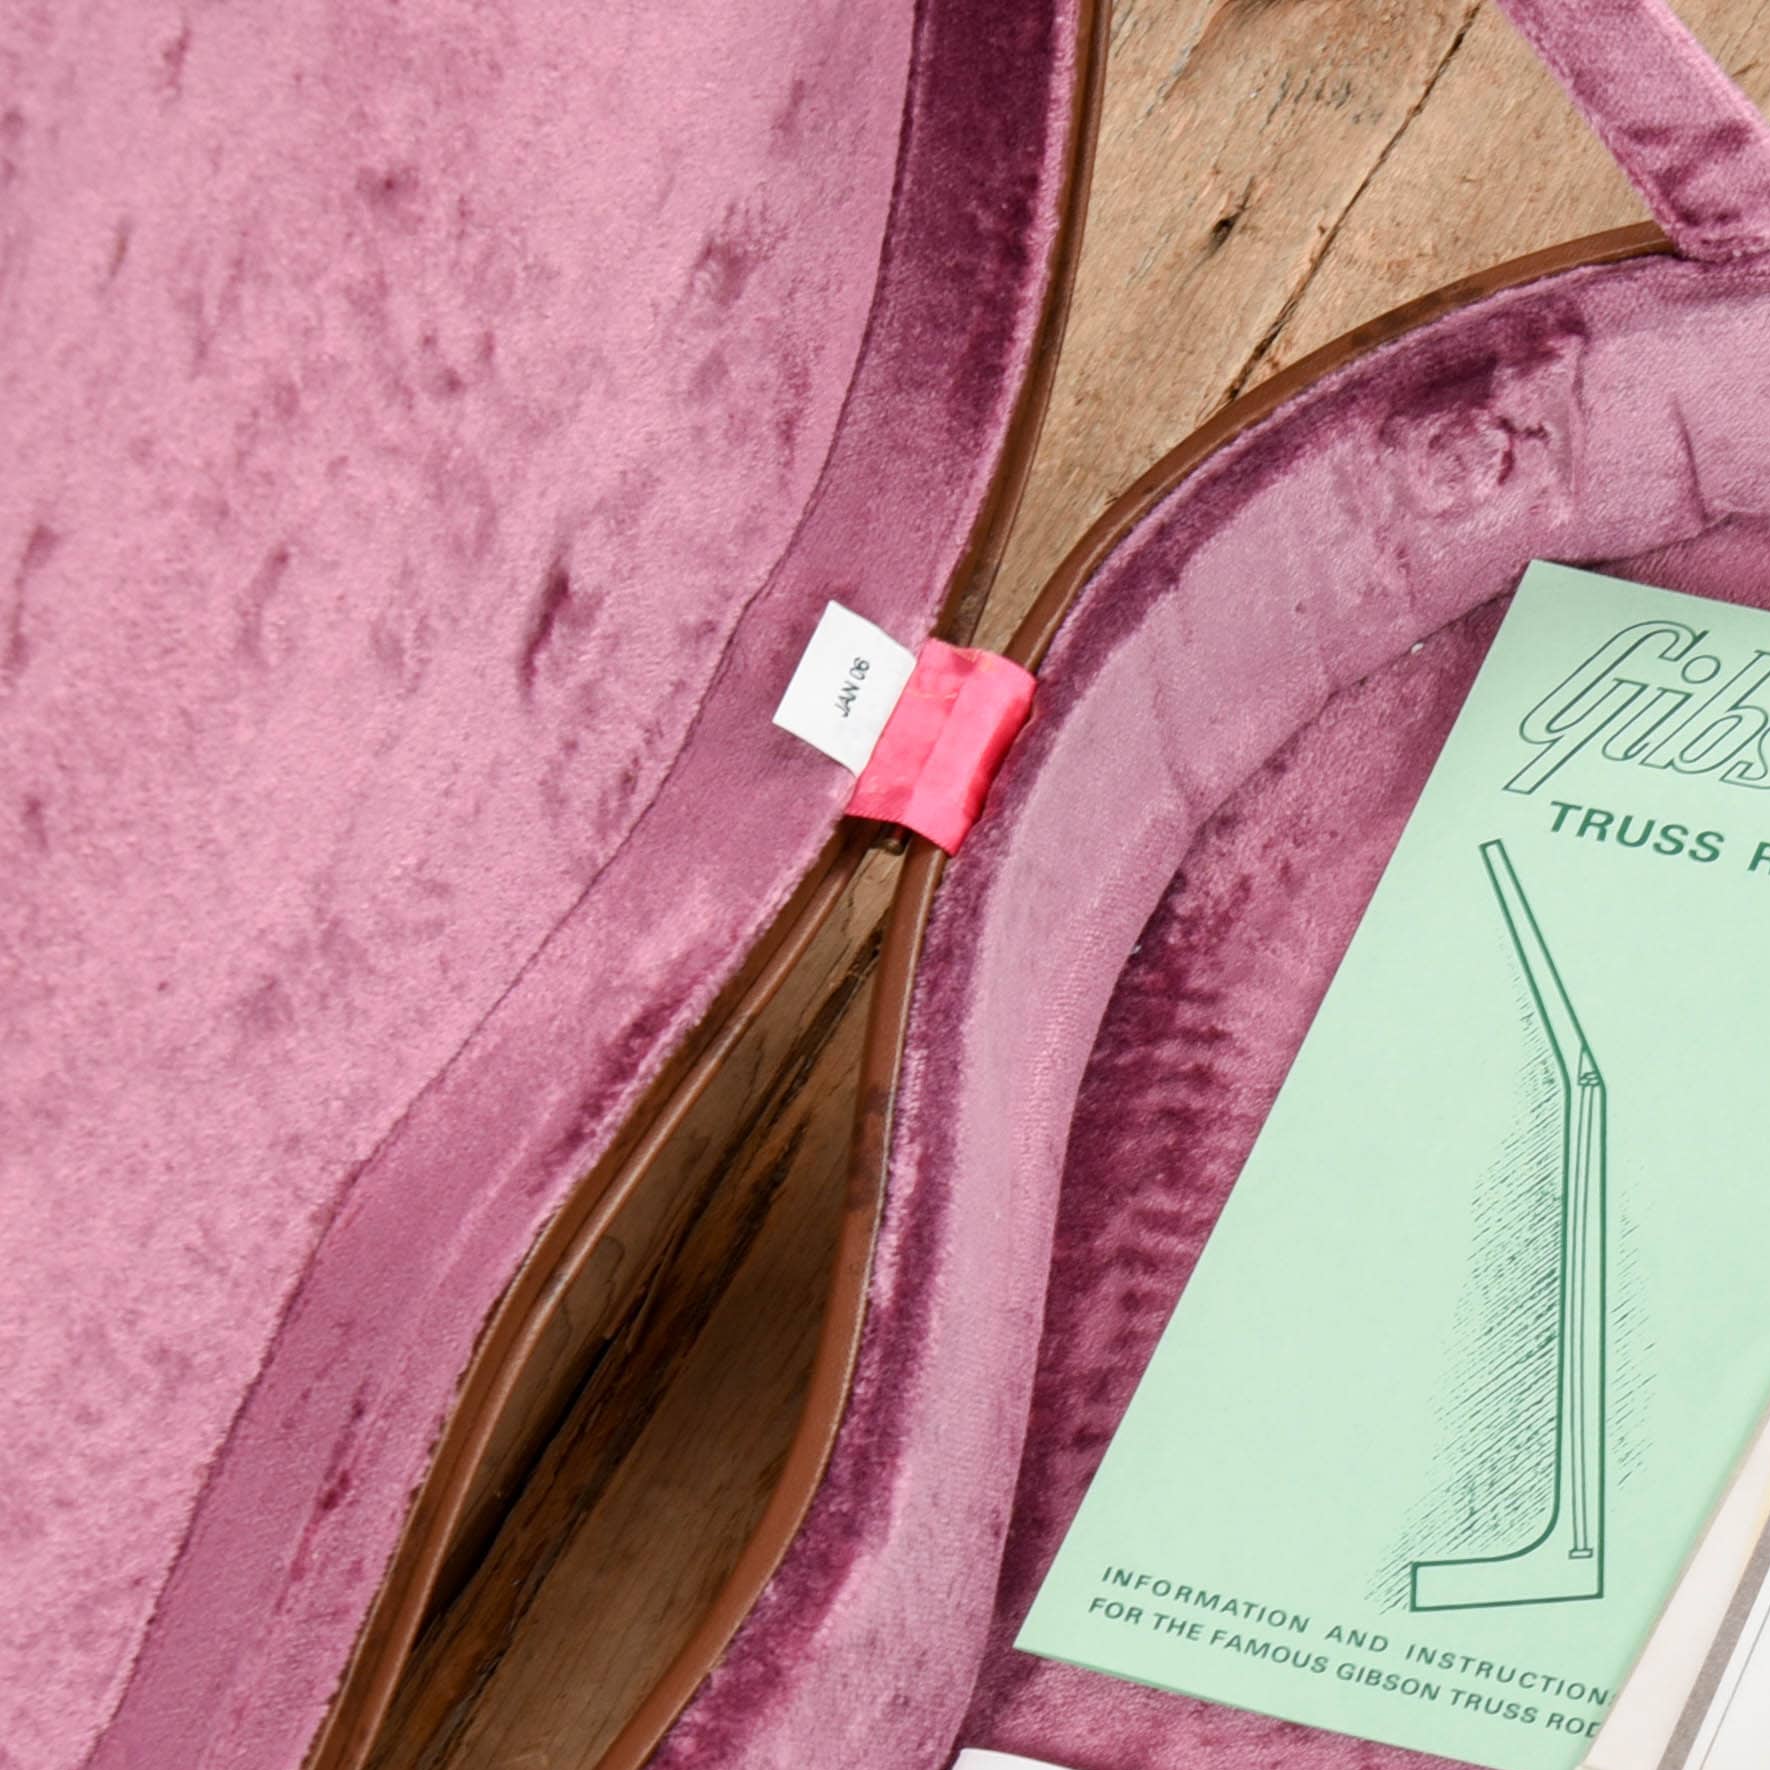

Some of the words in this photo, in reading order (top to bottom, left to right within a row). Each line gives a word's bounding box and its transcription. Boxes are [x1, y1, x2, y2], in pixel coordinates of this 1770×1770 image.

[1550, 801, 1725, 863] TRUSS
[1102, 1566, 1312, 1634] INFORMATION
[1325, 1623, 1390, 1654] AND
[1088, 1597, 1143, 1629] FOR
[1152, 1613, 1204, 1642] THE
[1208, 1628, 1330, 1676] FAMOUS
[1335, 1662, 1442, 1701] GIBSON
[1449, 1688, 1539, 1725] TRUSS
